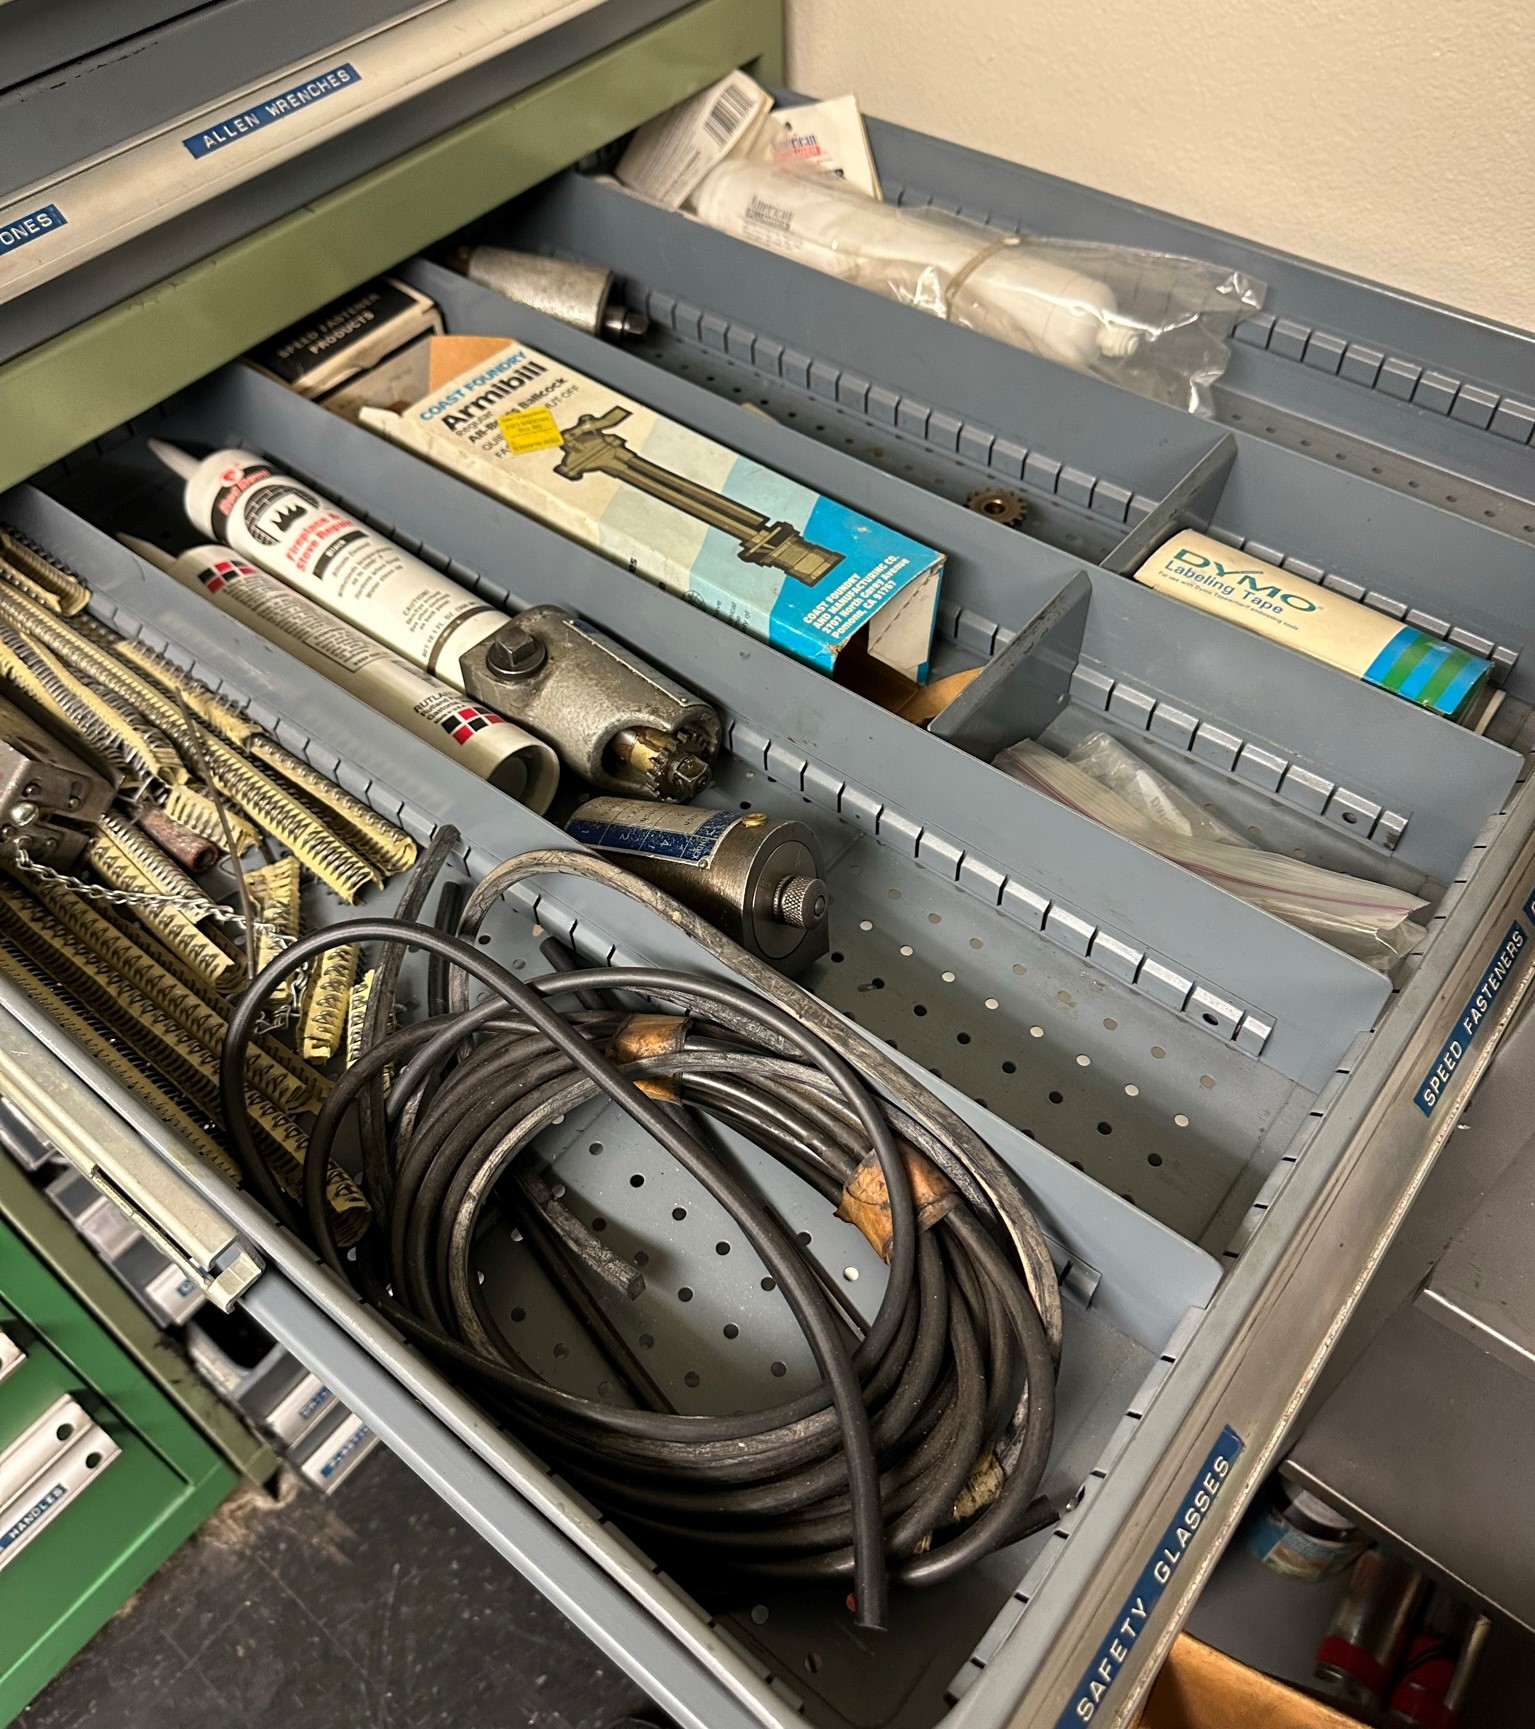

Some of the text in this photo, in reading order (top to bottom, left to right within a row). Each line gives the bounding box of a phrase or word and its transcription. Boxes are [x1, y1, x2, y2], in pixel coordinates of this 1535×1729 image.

[203, 69, 351, 149] ALLEN WRENCHES
[277, 330, 319, 359] SPEED
[307, 308, 375, 355] PRODUCTS
[419, 351, 527, 420] COAST FOUNDRY
[441, 360, 549, 432] Armibill
[518, 377, 567, 409] Ballcock
[455, 410, 492, 437] Regular
[286, 516, 330, 562] Fireplace
[296, 520, 352, 572] Stove Repair
[325, 538, 347, 557] Black
[803, 573, 861, 624] COAST FOUNDRY
[813, 555, 900, 630] AND MANUFACTURING CO.
[822, 615, 843, 634] 2707
[839, 597, 864, 617] North
[880, 558, 910, 581] Avenue
[1165, 560, 1283, 613] Labeling Tape
[1173, 549, 1317, 612] DYMO
[1180, 580, 1194, 588] with
[1195, 584, 1212, 595] Dymo
[1250, 606, 1283, 624] embossing
[830, 579, 897, 639] Pomona, CA 91767
[420, 698, 449, 717] Rutland
[1423, 930, 1526, 1107] SPEED FASTENERS
[9, 1487, 65, 1539] HANDLES
[1077, 1455, 1230, 1721] SAFETY GLASSES
